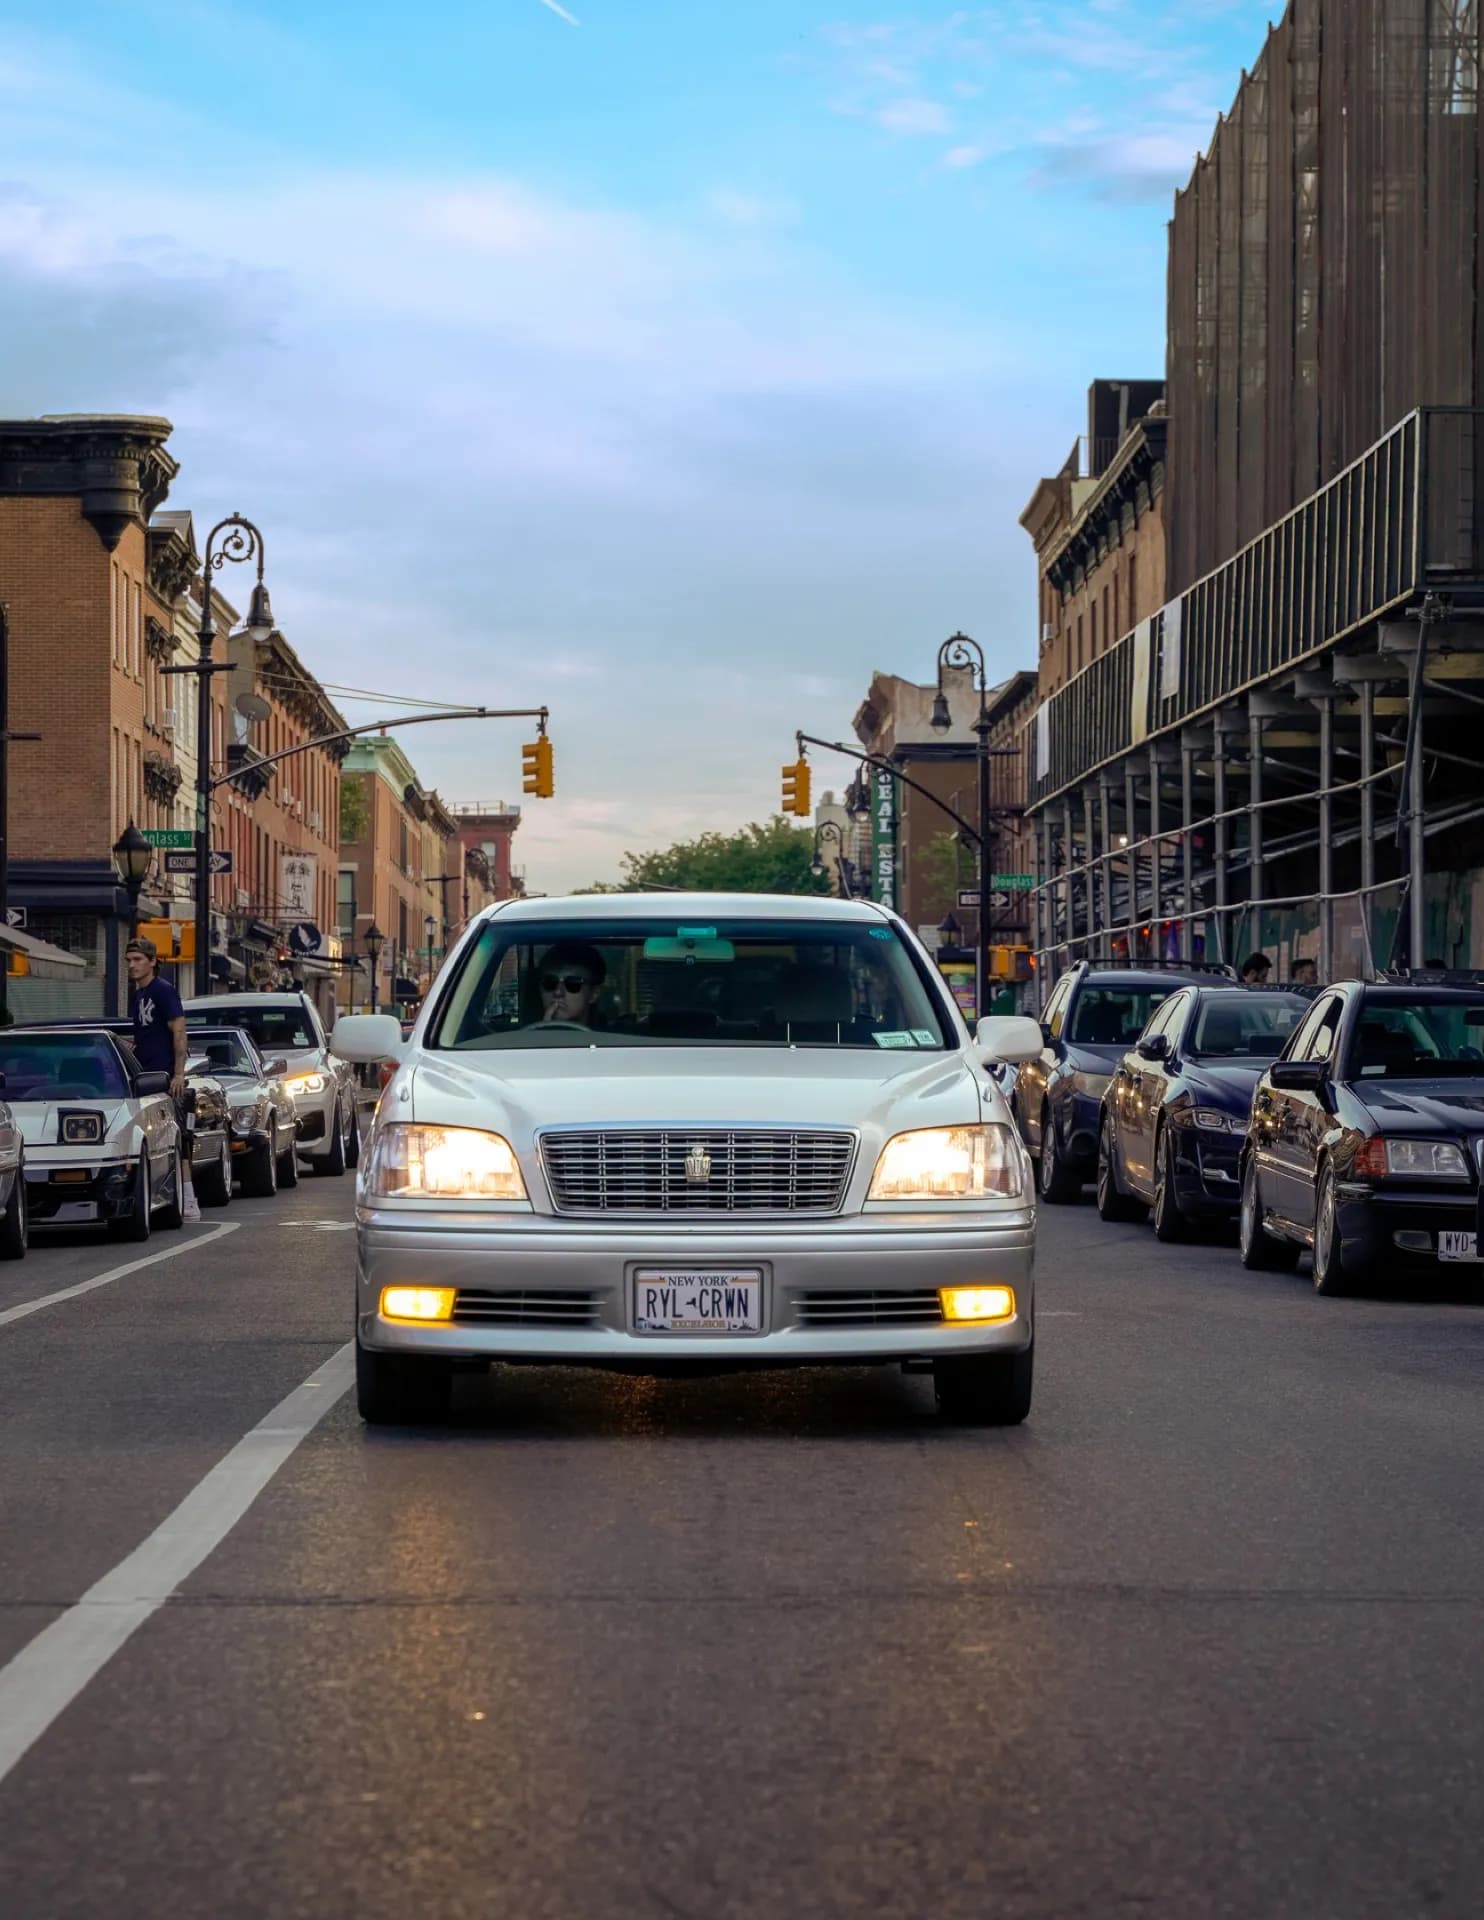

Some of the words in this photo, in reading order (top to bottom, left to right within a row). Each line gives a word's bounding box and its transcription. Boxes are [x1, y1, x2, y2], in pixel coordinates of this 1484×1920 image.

[171, 856, 189, 867] ONE
[668, 1275, 695, 1287] NEW
[697, 1275, 729, 1287] YORK
[646, 1288, 683, 1318] RYL
[699, 1288, 749, 1318] CRWN
